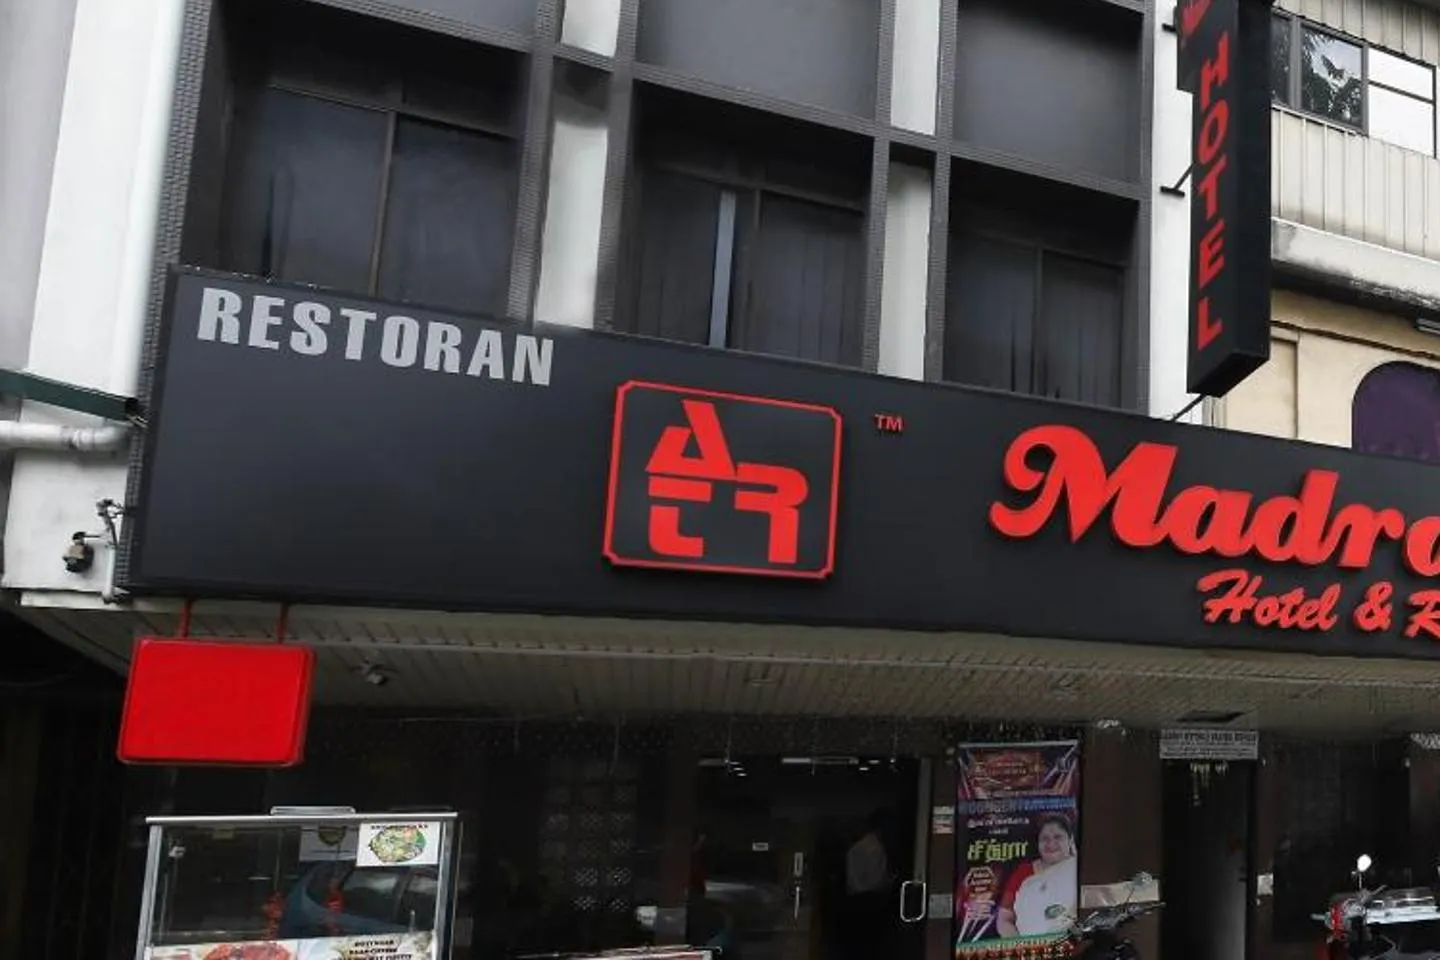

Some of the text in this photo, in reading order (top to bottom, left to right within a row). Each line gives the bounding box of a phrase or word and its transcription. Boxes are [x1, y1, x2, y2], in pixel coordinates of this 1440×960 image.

[1196, 30, 1230, 352] HOTEL
[197, 287, 554, 386] RESTORAN
[874, 413, 903, 432] TM
[1196, 568, 1341, 632] Hotel
[1353, 580, 1395, 632] &
